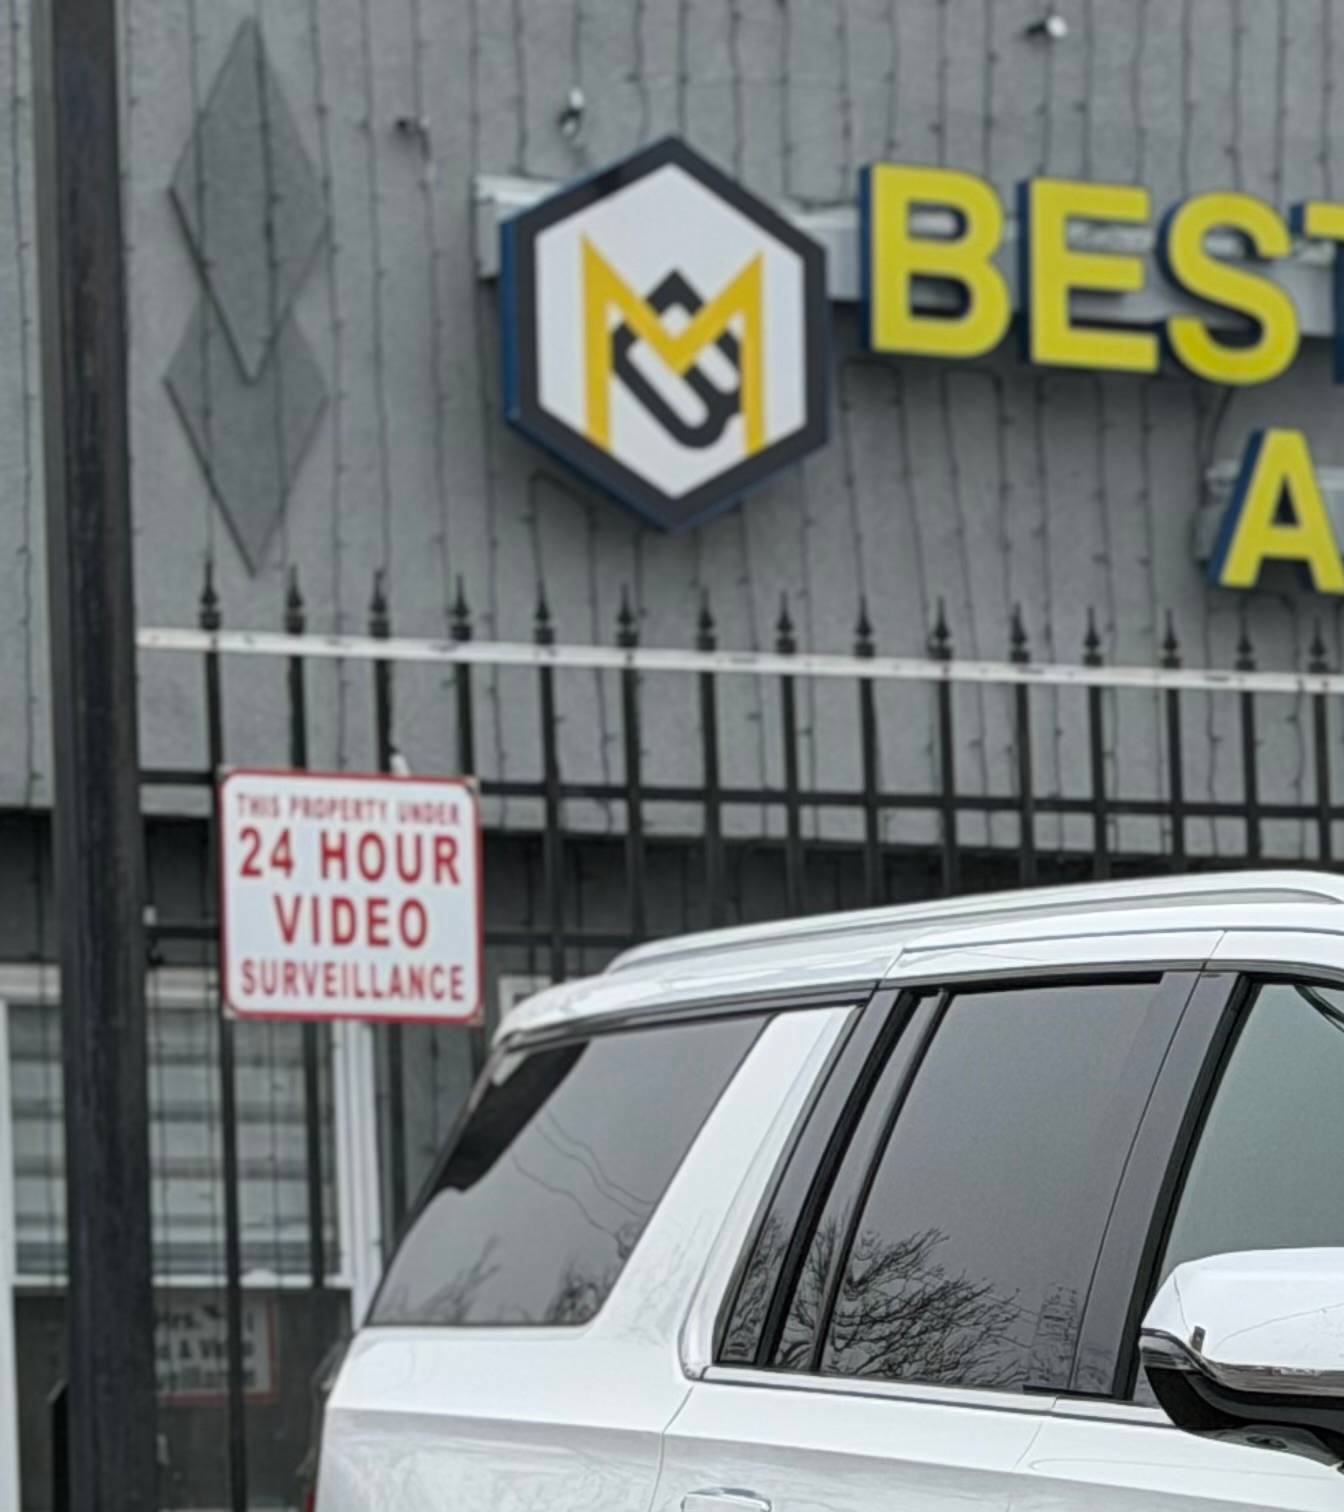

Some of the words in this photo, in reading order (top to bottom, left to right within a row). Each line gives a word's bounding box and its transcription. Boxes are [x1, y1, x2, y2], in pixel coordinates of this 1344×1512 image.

[237, 793, 280, 818] THIS
[289, 795, 388, 823] PROPERTY
[398, 801, 460, 826] UNDER
[239, 826, 295, 879] 24
[319, 829, 460, 886] HOUR
[273, 893, 429, 949] VIDEO
[241, 958, 465, 1002] SURVEILLANCE
